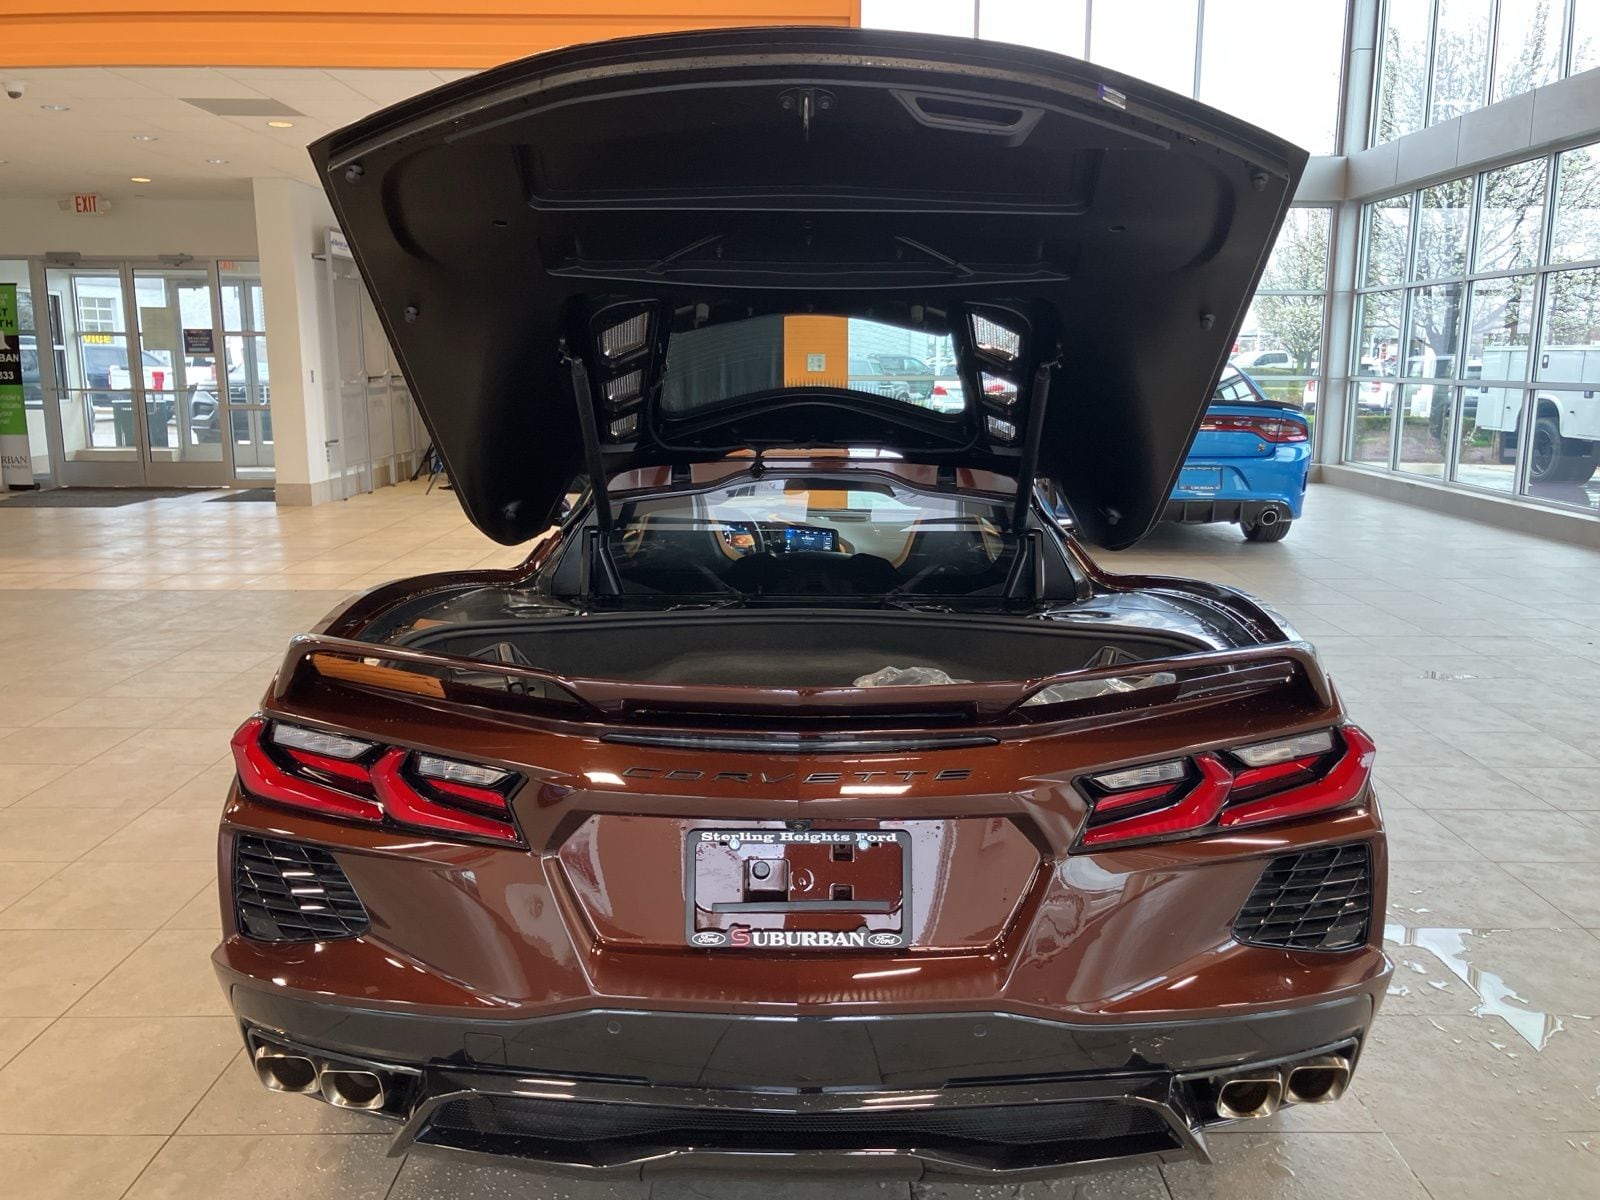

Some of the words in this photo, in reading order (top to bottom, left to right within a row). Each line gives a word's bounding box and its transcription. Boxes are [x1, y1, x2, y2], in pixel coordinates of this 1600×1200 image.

[75, 195, 97, 213] EXIT
[622, 767, 972, 785] CORVETTE
[701, 832, 775, 843] Sterling
[779, 832, 850, 843] Heights
[855, 832, 897, 842] Ford
[697, 933, 720, 944] Ford
[730, 928, 865, 947] SUBURBAN
[873, 934, 896, 945] Ford
